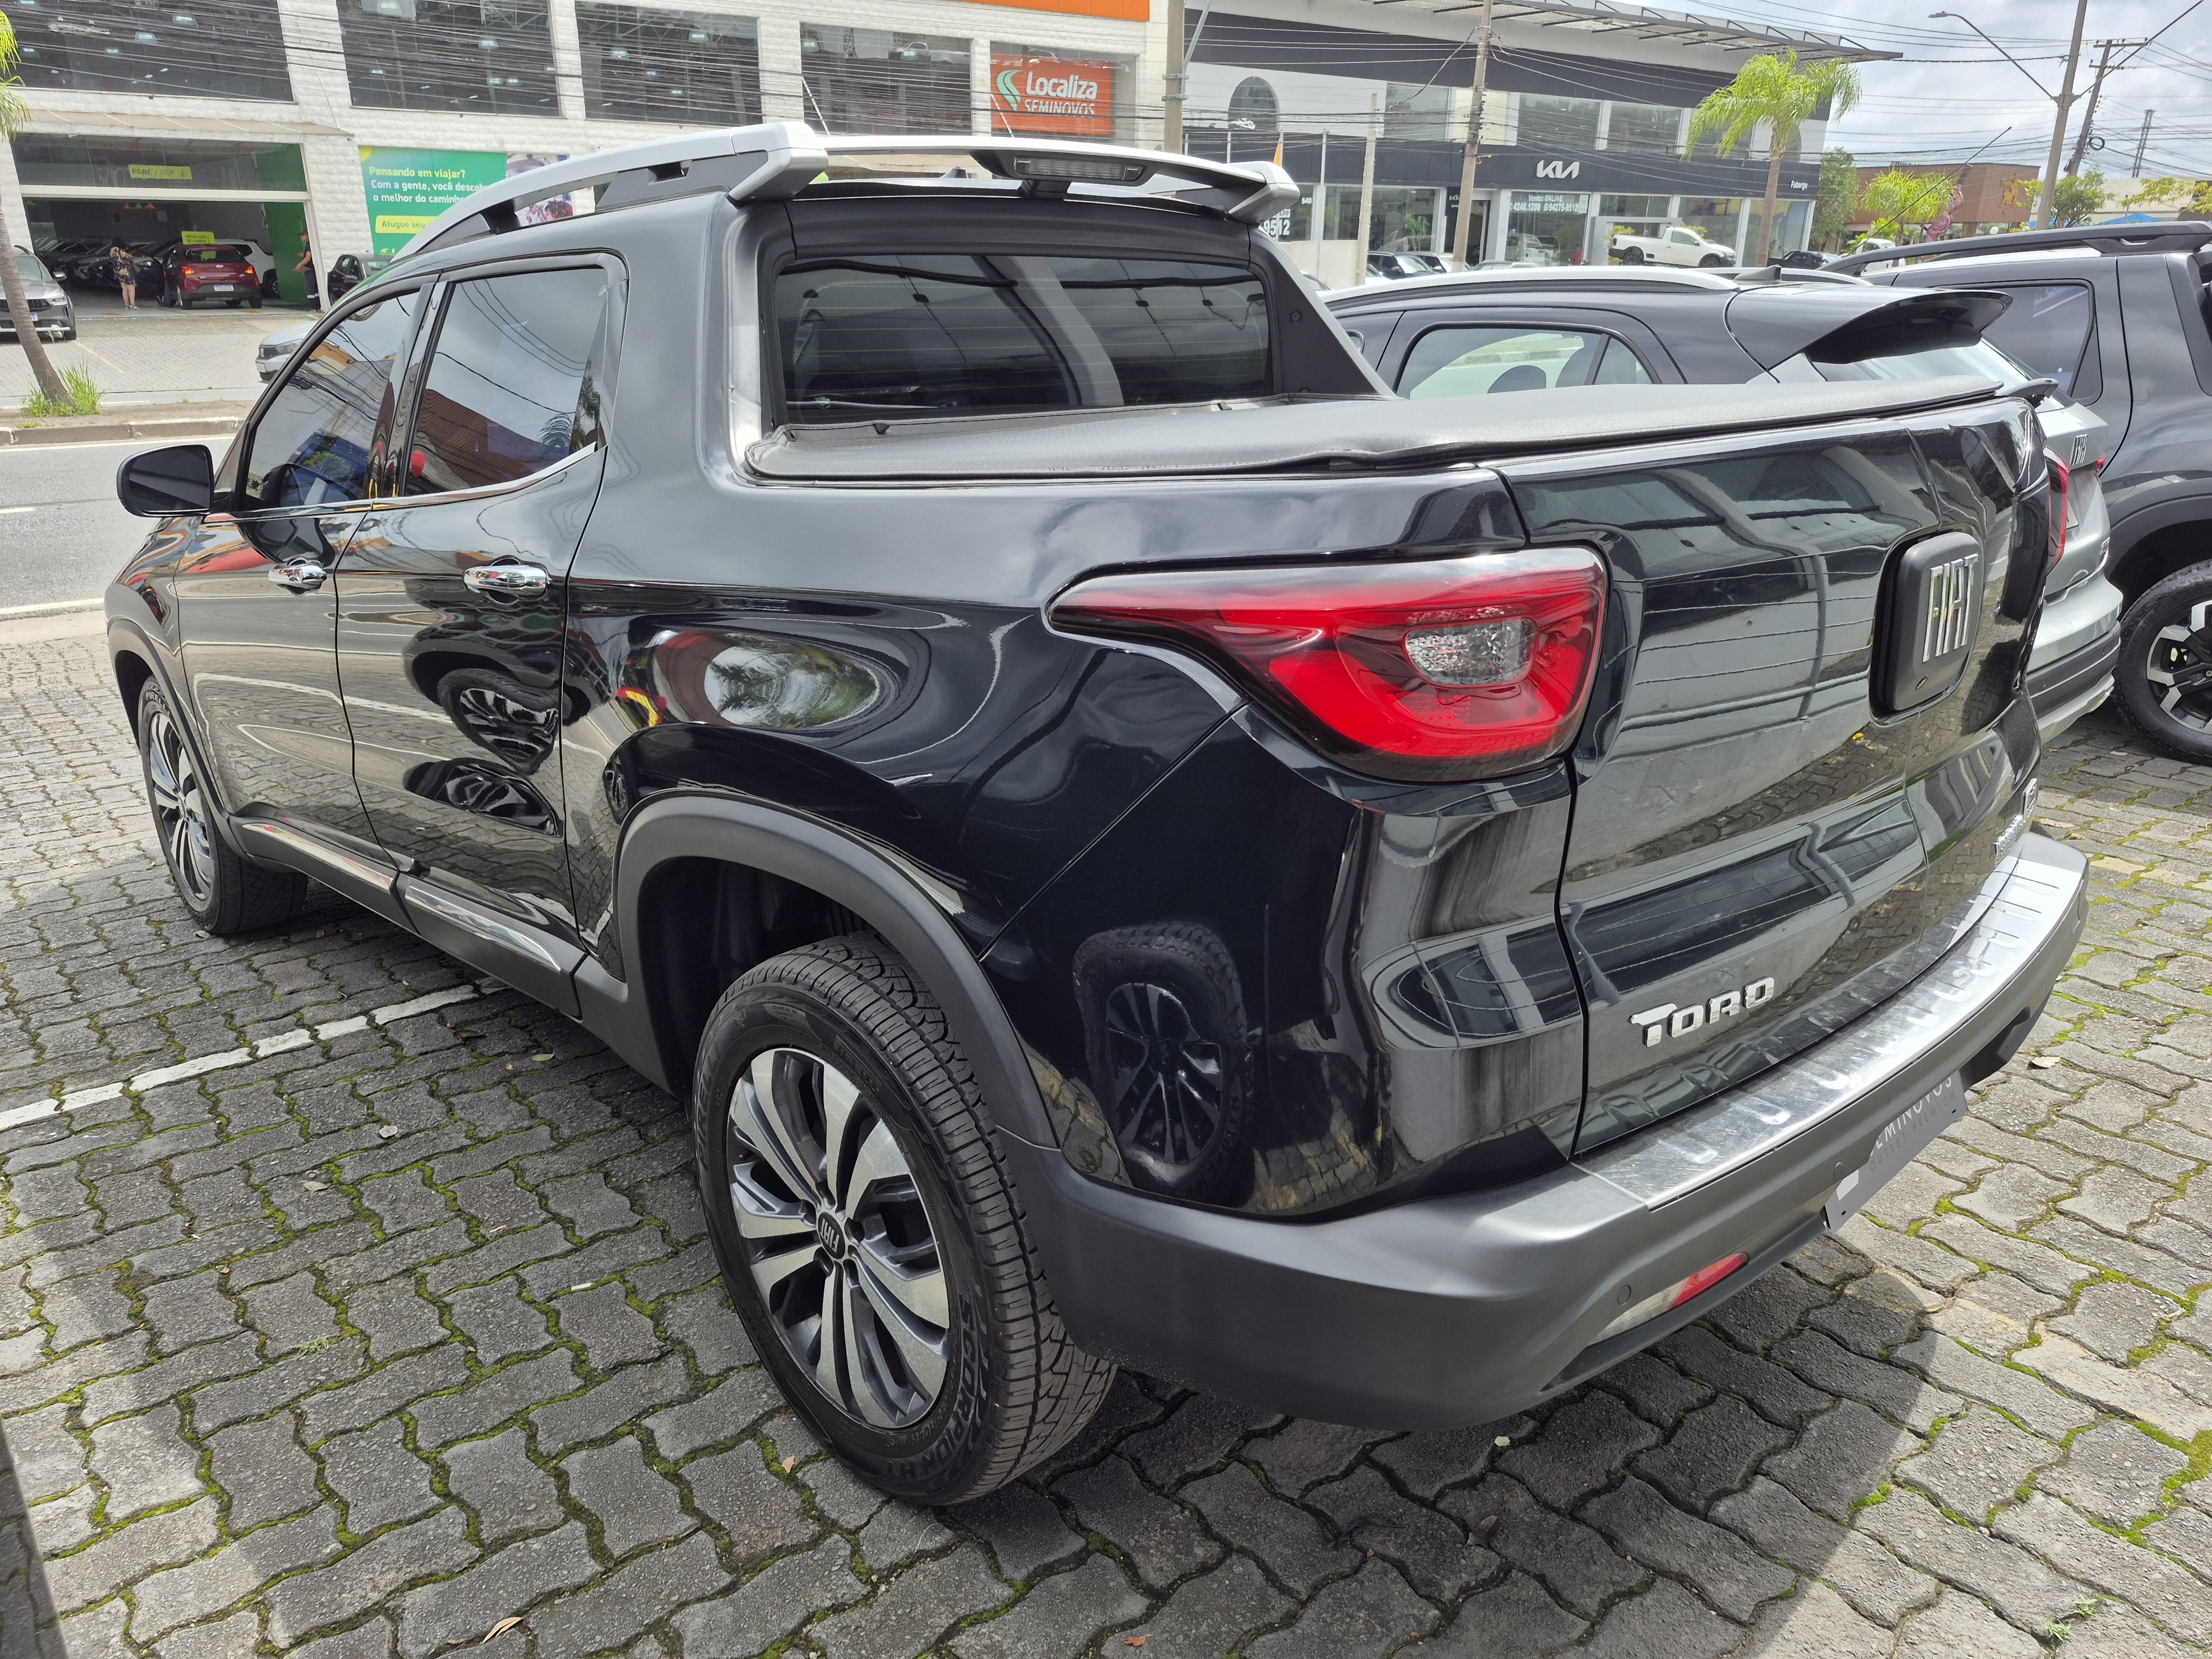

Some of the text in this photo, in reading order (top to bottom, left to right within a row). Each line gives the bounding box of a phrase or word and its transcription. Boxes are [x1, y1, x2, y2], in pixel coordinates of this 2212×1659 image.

[1026, 71, 1097, 100] Localiza
[1024, 99, 1095, 118] SEMINOVOS
[369, 166, 415, 177] Pensando
[434, 169, 466, 180] viajar?
[1536, 159, 1580, 179] KIA
[371, 180, 392, 189] Com
[402, 181, 430, 191] gente,
[432, 181, 453, 191] você
[455, 182, 488, 192] descob
[1791, 180, 1808, 191] Faberge
[381, 193, 413, 203] melhor
[415, 194, 427, 203] do
[428, 195, 466, 204] caminh
[1513, 202, 1541, 212] 4240.1200
[1549, 202, 1578, 212] 94275-9512
[382, 220, 410, 229] Alugue
[1922, 554, 1979, 663] FIAT
[1627, 976, 1775, 1047] TORO
[697, 1037, 721, 1172] PIRELLI
[1870, 1077, 1952, 1157] EMINOVOS
[1869, 1091, 1957, 1171] OUTLET PREMIUM
[820, 1218, 840, 1254] FIAT
[922, 1293, 978, 1473] SCORPION
